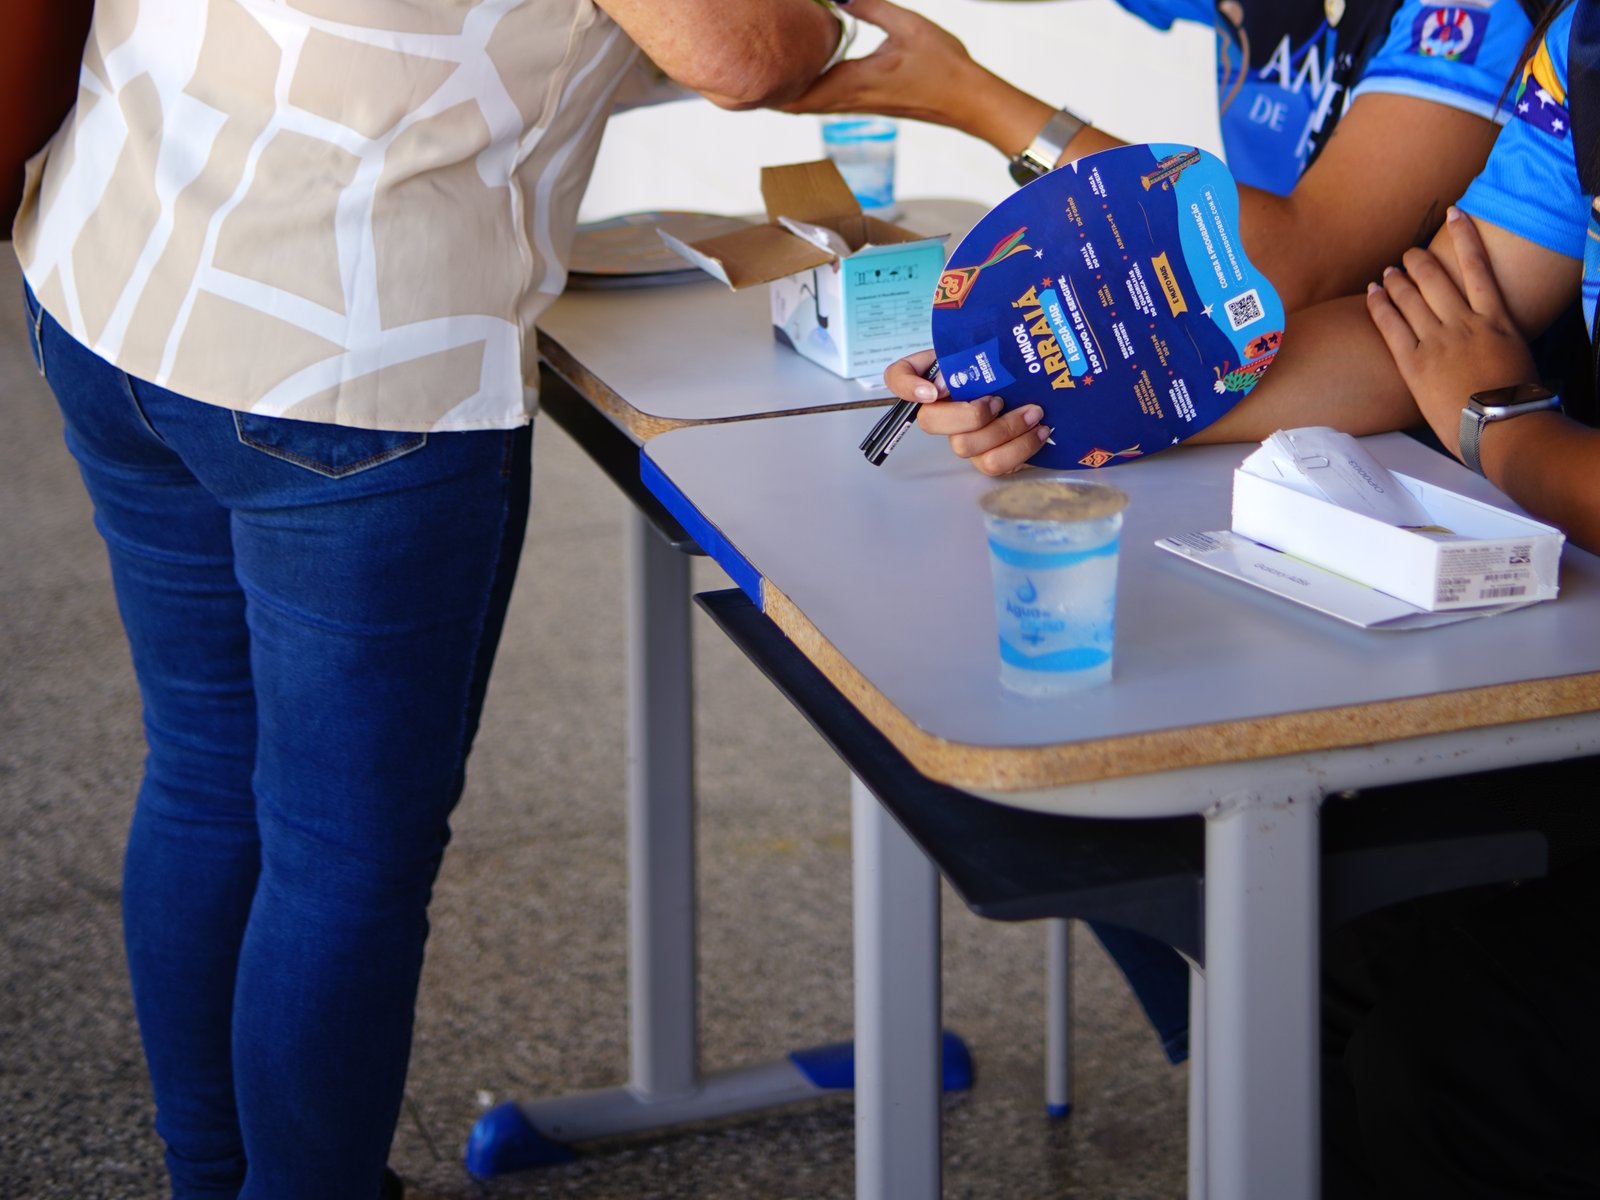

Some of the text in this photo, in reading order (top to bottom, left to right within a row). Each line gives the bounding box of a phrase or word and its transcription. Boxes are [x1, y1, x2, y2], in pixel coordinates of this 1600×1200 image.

[1249, 94, 1288, 132] DE
[1088, 175, 1099, 194] APAGA
[1092, 166, 1107, 197] FOGUEIRA
[1065, 207, 1074, 222] VILA
[1075, 216, 1083, 226] DO
[1106, 213, 1124, 249] ARRASTA-FÉ
[1190, 203, 1214, 254] PROGRAMAÇÃO
[1205, 191, 1242, 280] SERGIPEPAISDOFORRO.COM.BR
[1085, 242, 1099, 268] DO POVO
[1159, 265, 1169, 280] MAIS
[1165, 279, 1177, 299] MUITO
[1212, 259, 1227, 288] CONFIRA
[1125, 279, 1141, 310] CONCURSO
[1128, 269, 1149, 314] DE QUADRILHAS
[1011, 285, 1075, 390] ARRAIÁ
[1048, 302, 1080, 361] À BEIRA-MAR
[1057, 275, 1102, 374] É DO POVO. É DE SERGIPE.
[1112, 323, 1129, 359] SEGUNDONA
[1118, 321, 1134, 355] DO TURISTA
[1012, 323, 1040, 373] O MAIOR
[975, 353, 993, 383] SERGIPE
[1168, 388, 1183, 418] CONCURSO
[1171, 379, 1191, 422] DE QUADRILHAS
